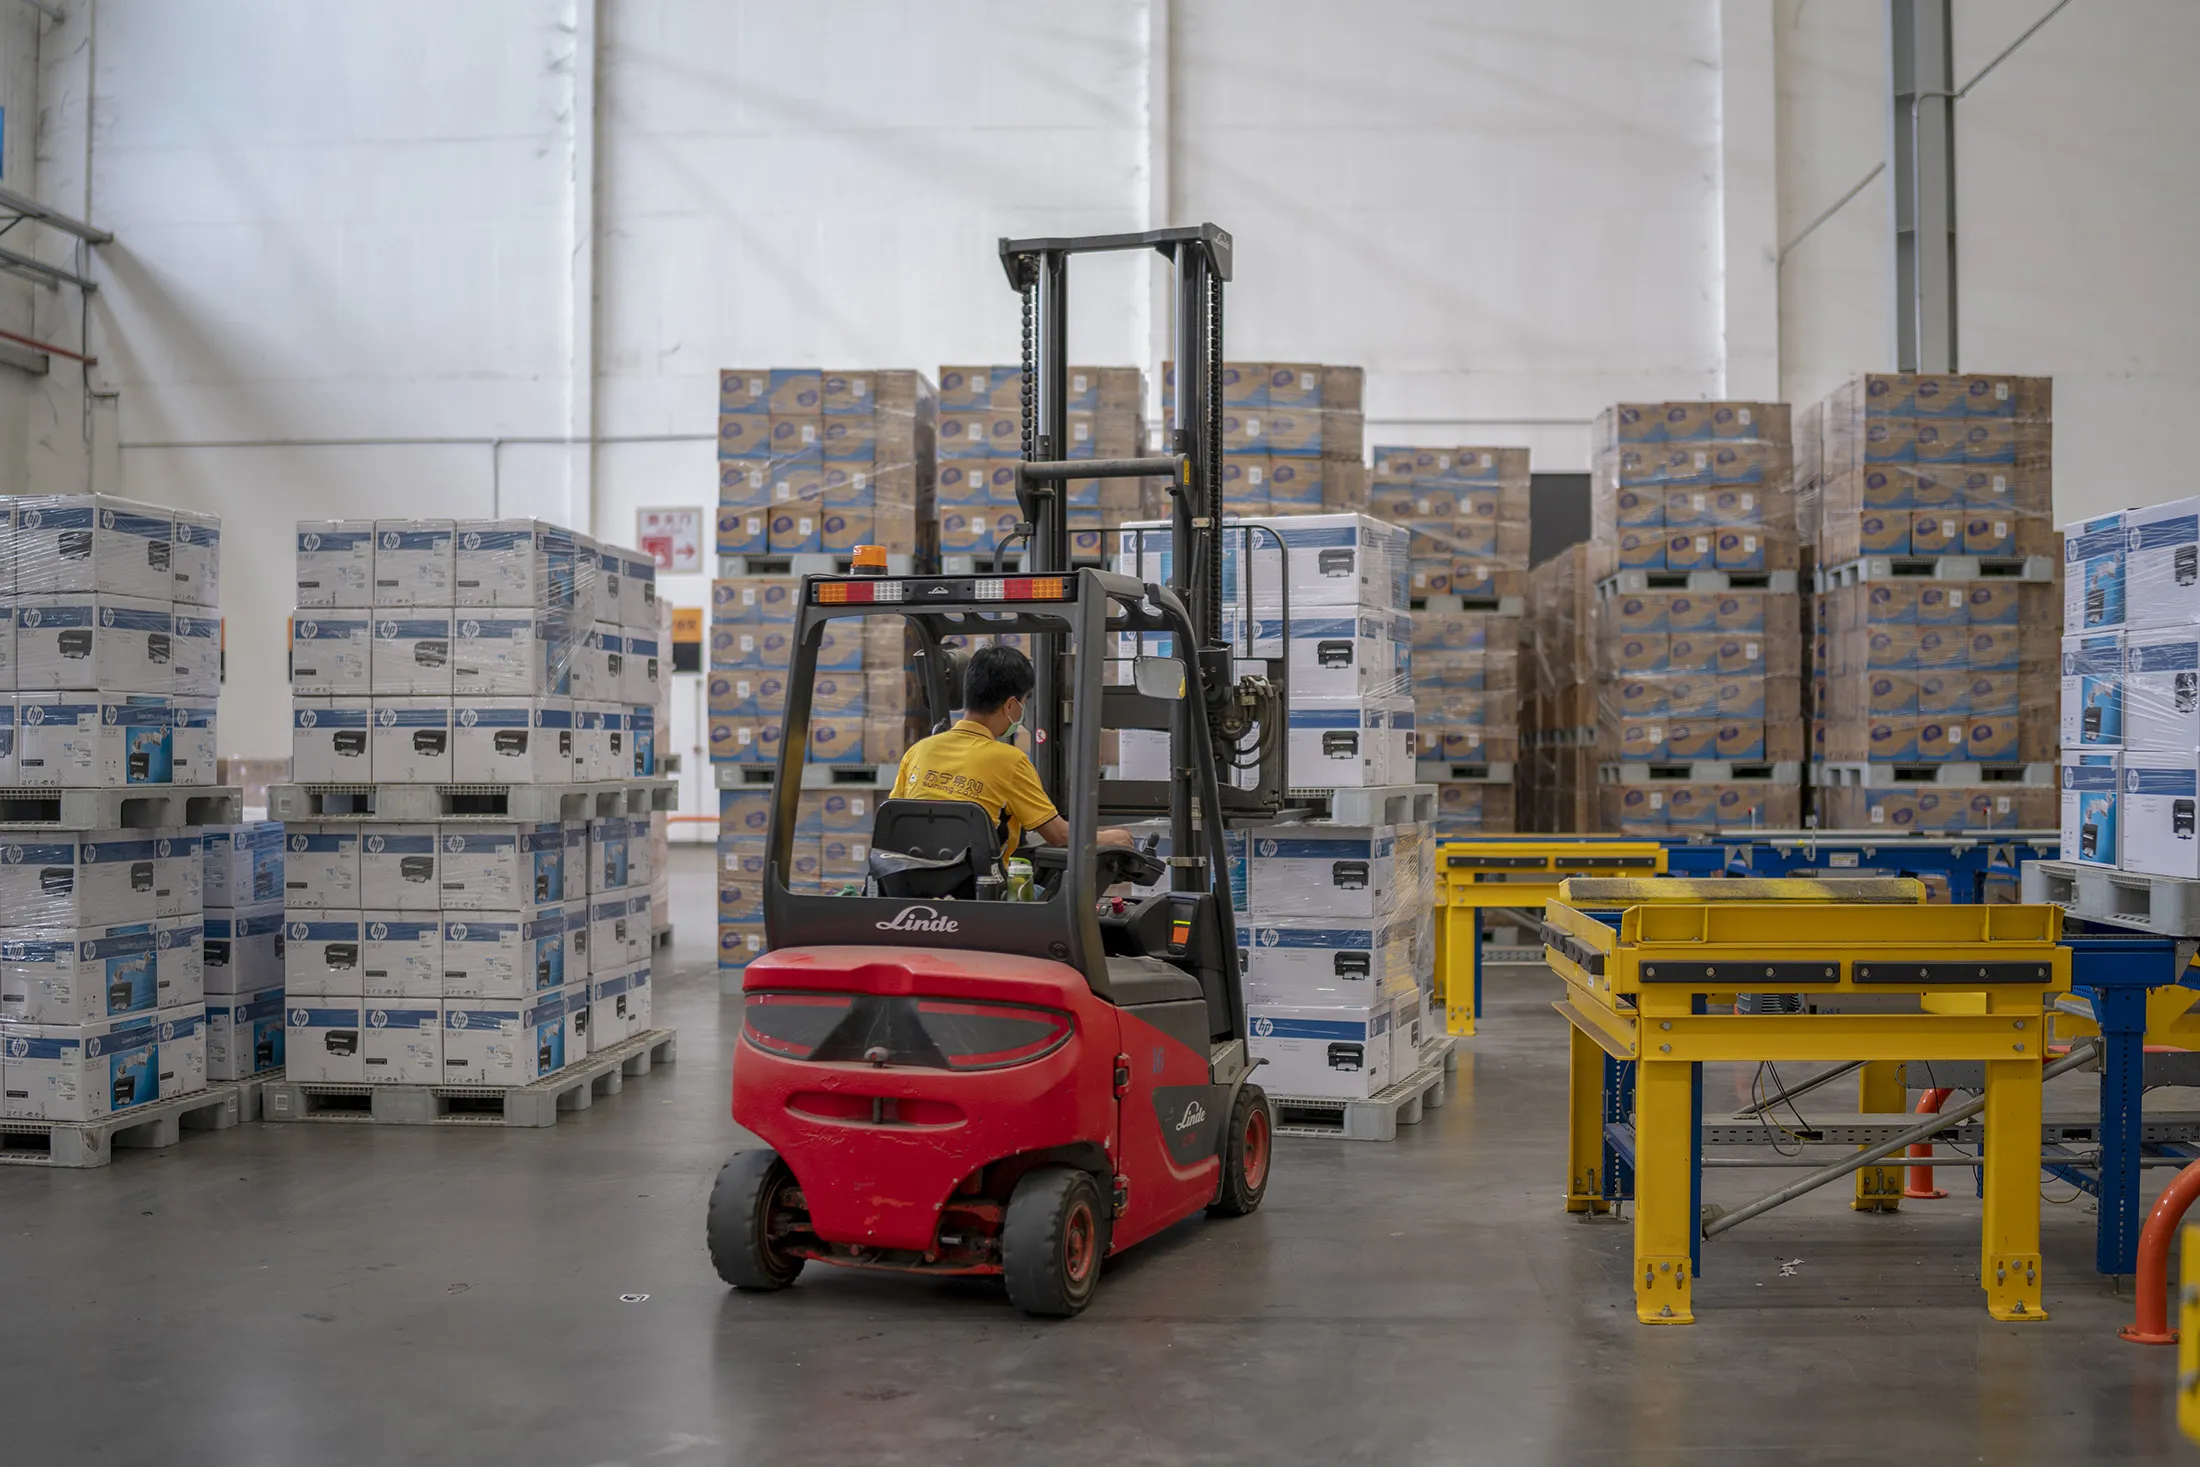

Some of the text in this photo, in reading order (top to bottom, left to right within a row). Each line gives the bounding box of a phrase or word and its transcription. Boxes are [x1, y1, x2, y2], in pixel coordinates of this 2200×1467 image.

[26, 510, 40, 529] hp
[305, 533, 319, 551] hp
[385, 532, 399, 550] hp
[465, 532, 479, 550] hp
[25, 608, 40, 628] hp
[302, 621, 316, 639] hp
[382, 621, 396, 639] hp
[464, 620, 478, 638] hp
[28, 705, 43, 726] hp
[302, 709, 316, 728] hp
[381, 709, 396, 727] hp
[462, 709, 477, 727] hp
[924, 769, 984, 794] 苏宁易购
[293, 834, 307, 852] hp
[369, 835, 383, 853] hp
[450, 835, 464, 853] hp
[1261, 839, 1276, 857] hp
[8, 844, 22, 864] hp
[875, 905, 959, 932] Linde
[293, 922, 307, 940] hp
[372, 922, 386, 940] hp
[452, 922, 466, 941] hp
[1262, 928, 1278, 947] hp
[293, 1008, 308, 1027] hp
[372, 1010, 386, 1028] hp
[453, 1011, 467, 1029] hp
[1257, 1018, 1272, 1037] hp
[13, 1038, 27, 1058] hp
[1153, 1046, 1164, 1073] 16
[1176, 1100, 1206, 1130] Linde
